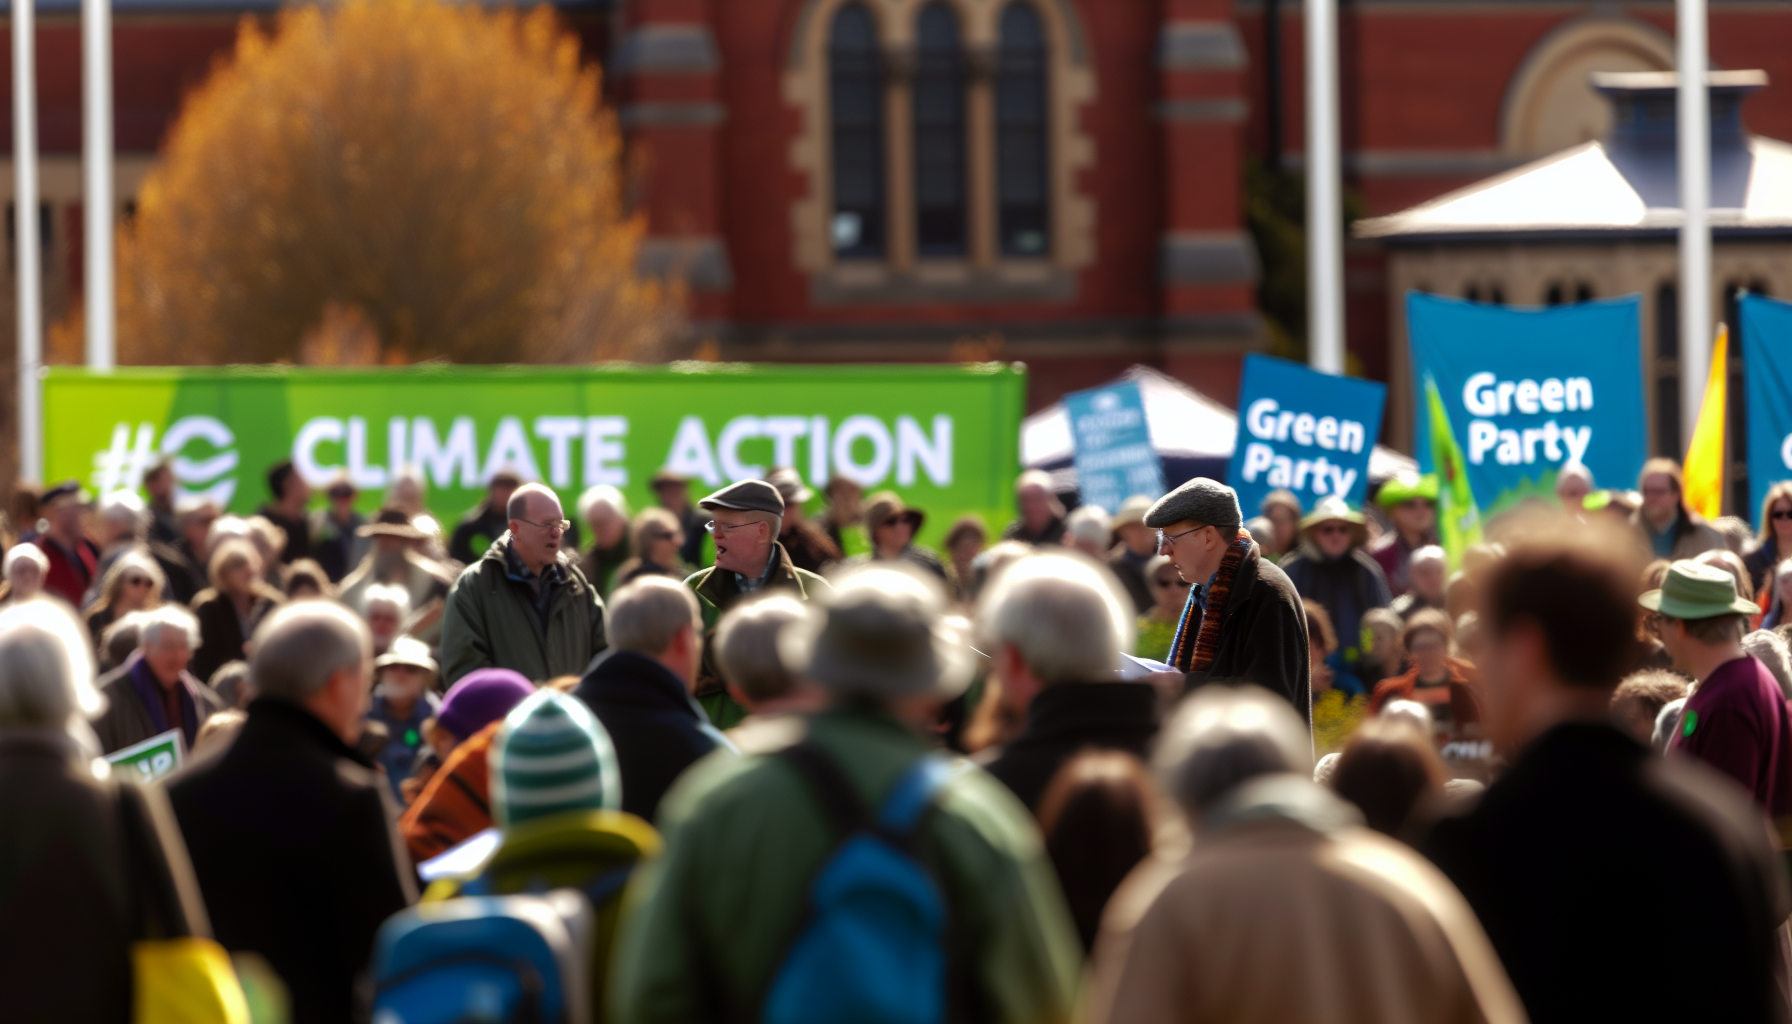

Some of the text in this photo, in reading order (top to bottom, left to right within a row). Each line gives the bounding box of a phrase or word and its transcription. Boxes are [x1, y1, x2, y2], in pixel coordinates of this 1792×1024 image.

[1463, 371, 1593, 417] Green
[294, 415, 628, 489] CLIMATE
[660, 414, 952, 488] ACTION
[1246, 398, 1365, 454] Green
[1468, 419, 1592, 471] Party
[1241, 442, 1358, 500] Party
